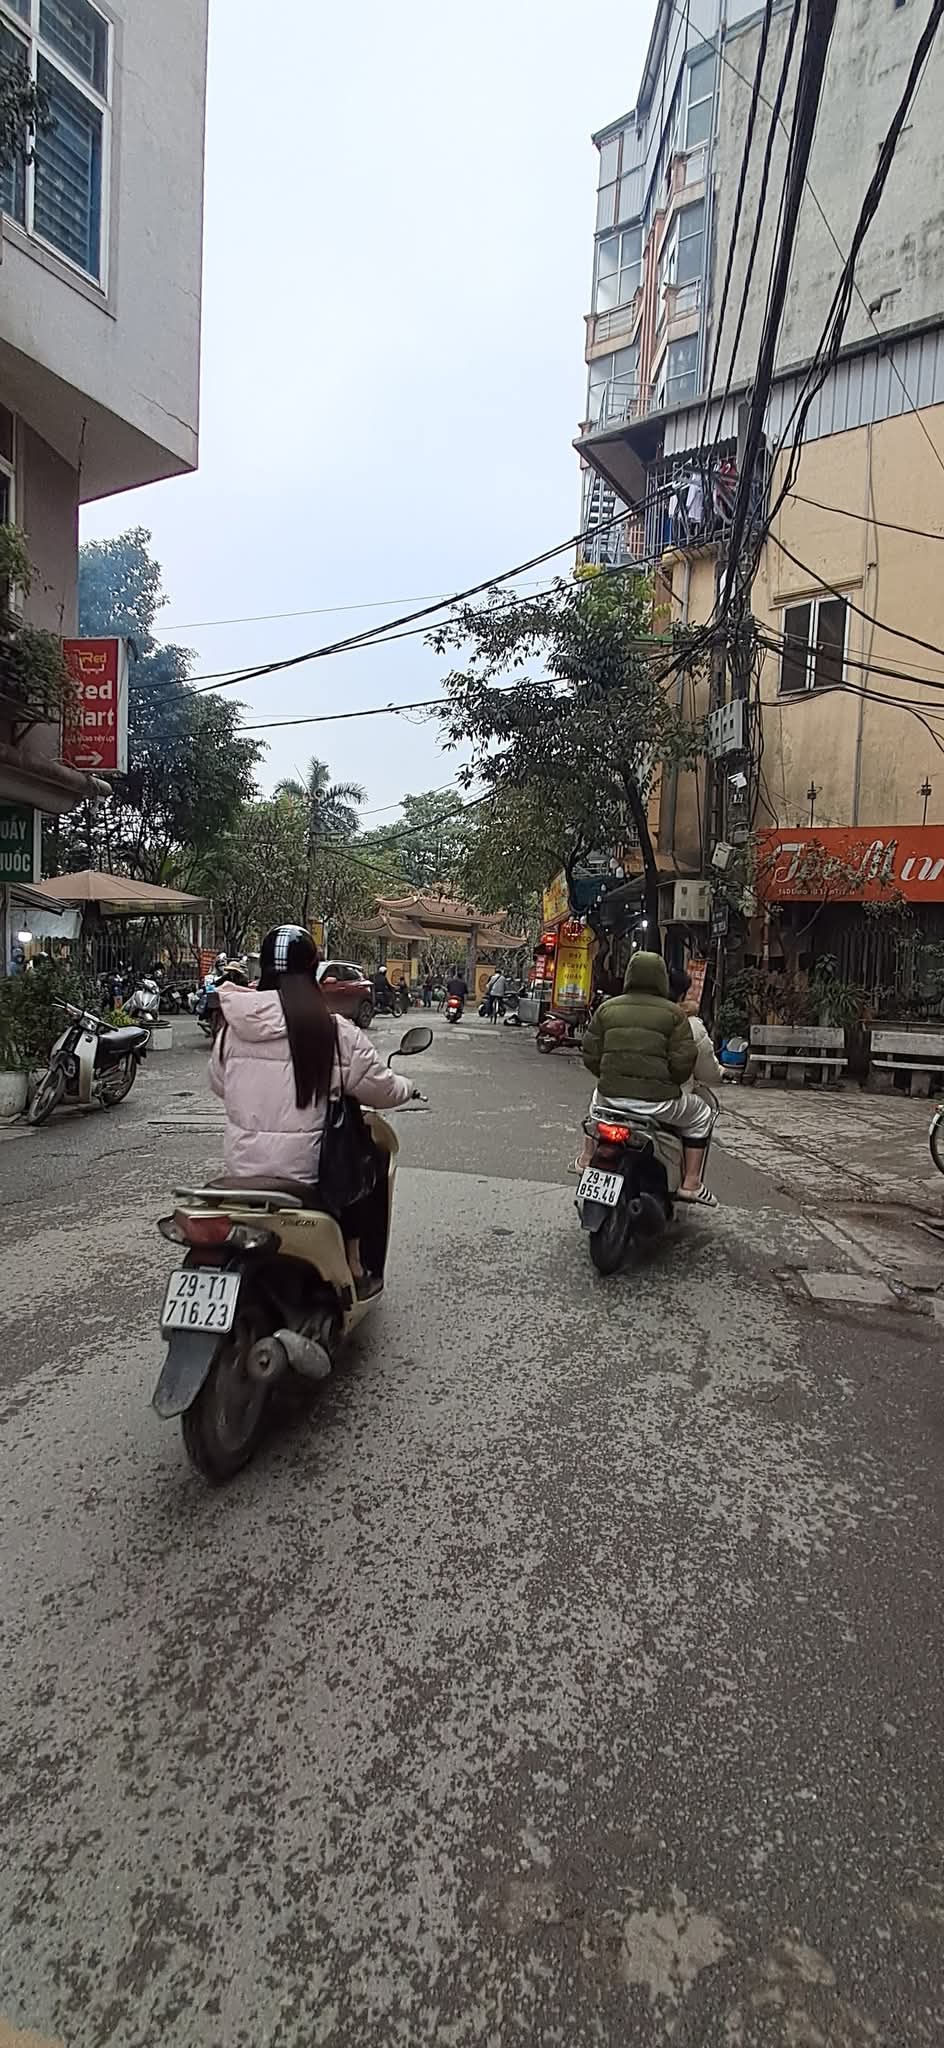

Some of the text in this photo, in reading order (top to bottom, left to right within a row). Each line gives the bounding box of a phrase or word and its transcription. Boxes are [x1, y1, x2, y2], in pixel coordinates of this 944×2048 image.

[586, 1170, 617, 1190] 29-M1
[176, 1274, 227, 1300] 29-T1
[166, 1300, 228, 1327] 716.23
